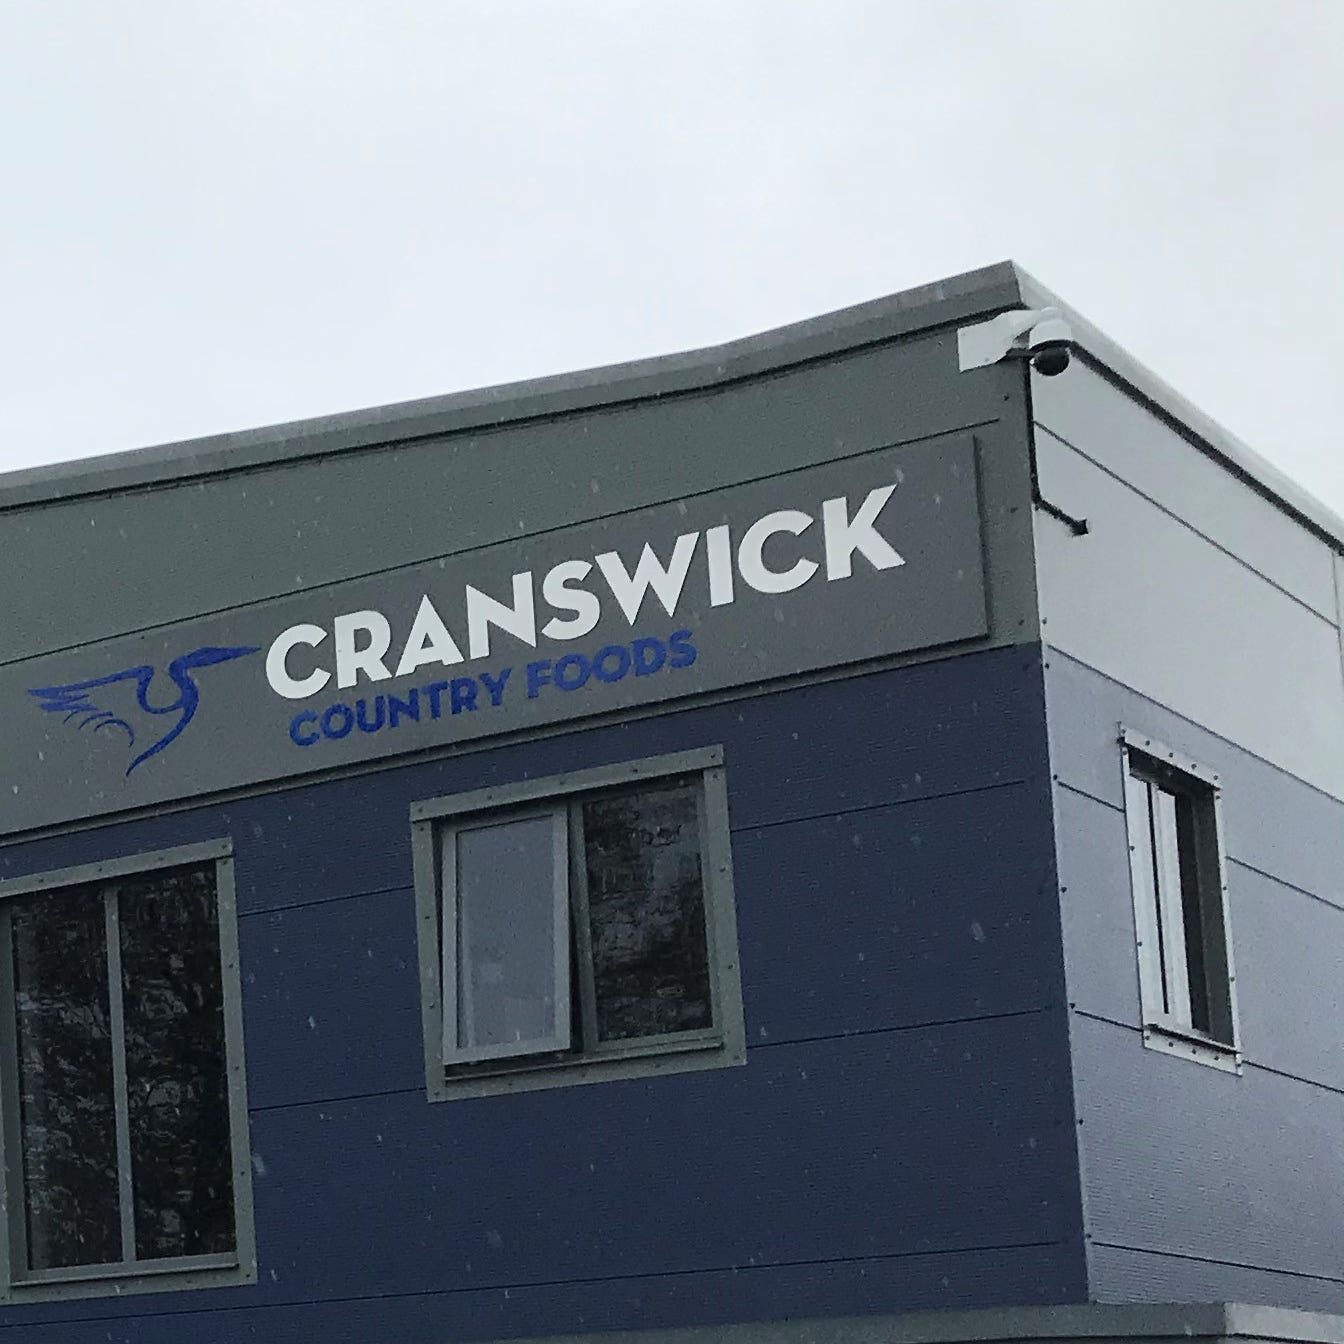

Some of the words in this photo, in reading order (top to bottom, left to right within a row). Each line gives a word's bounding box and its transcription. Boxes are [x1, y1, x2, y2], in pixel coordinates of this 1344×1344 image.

[265, 483, 906, 699] CRANSWICK
[288, 666, 513, 748] COUNTRY
[524, 627, 699, 699] FOODS
